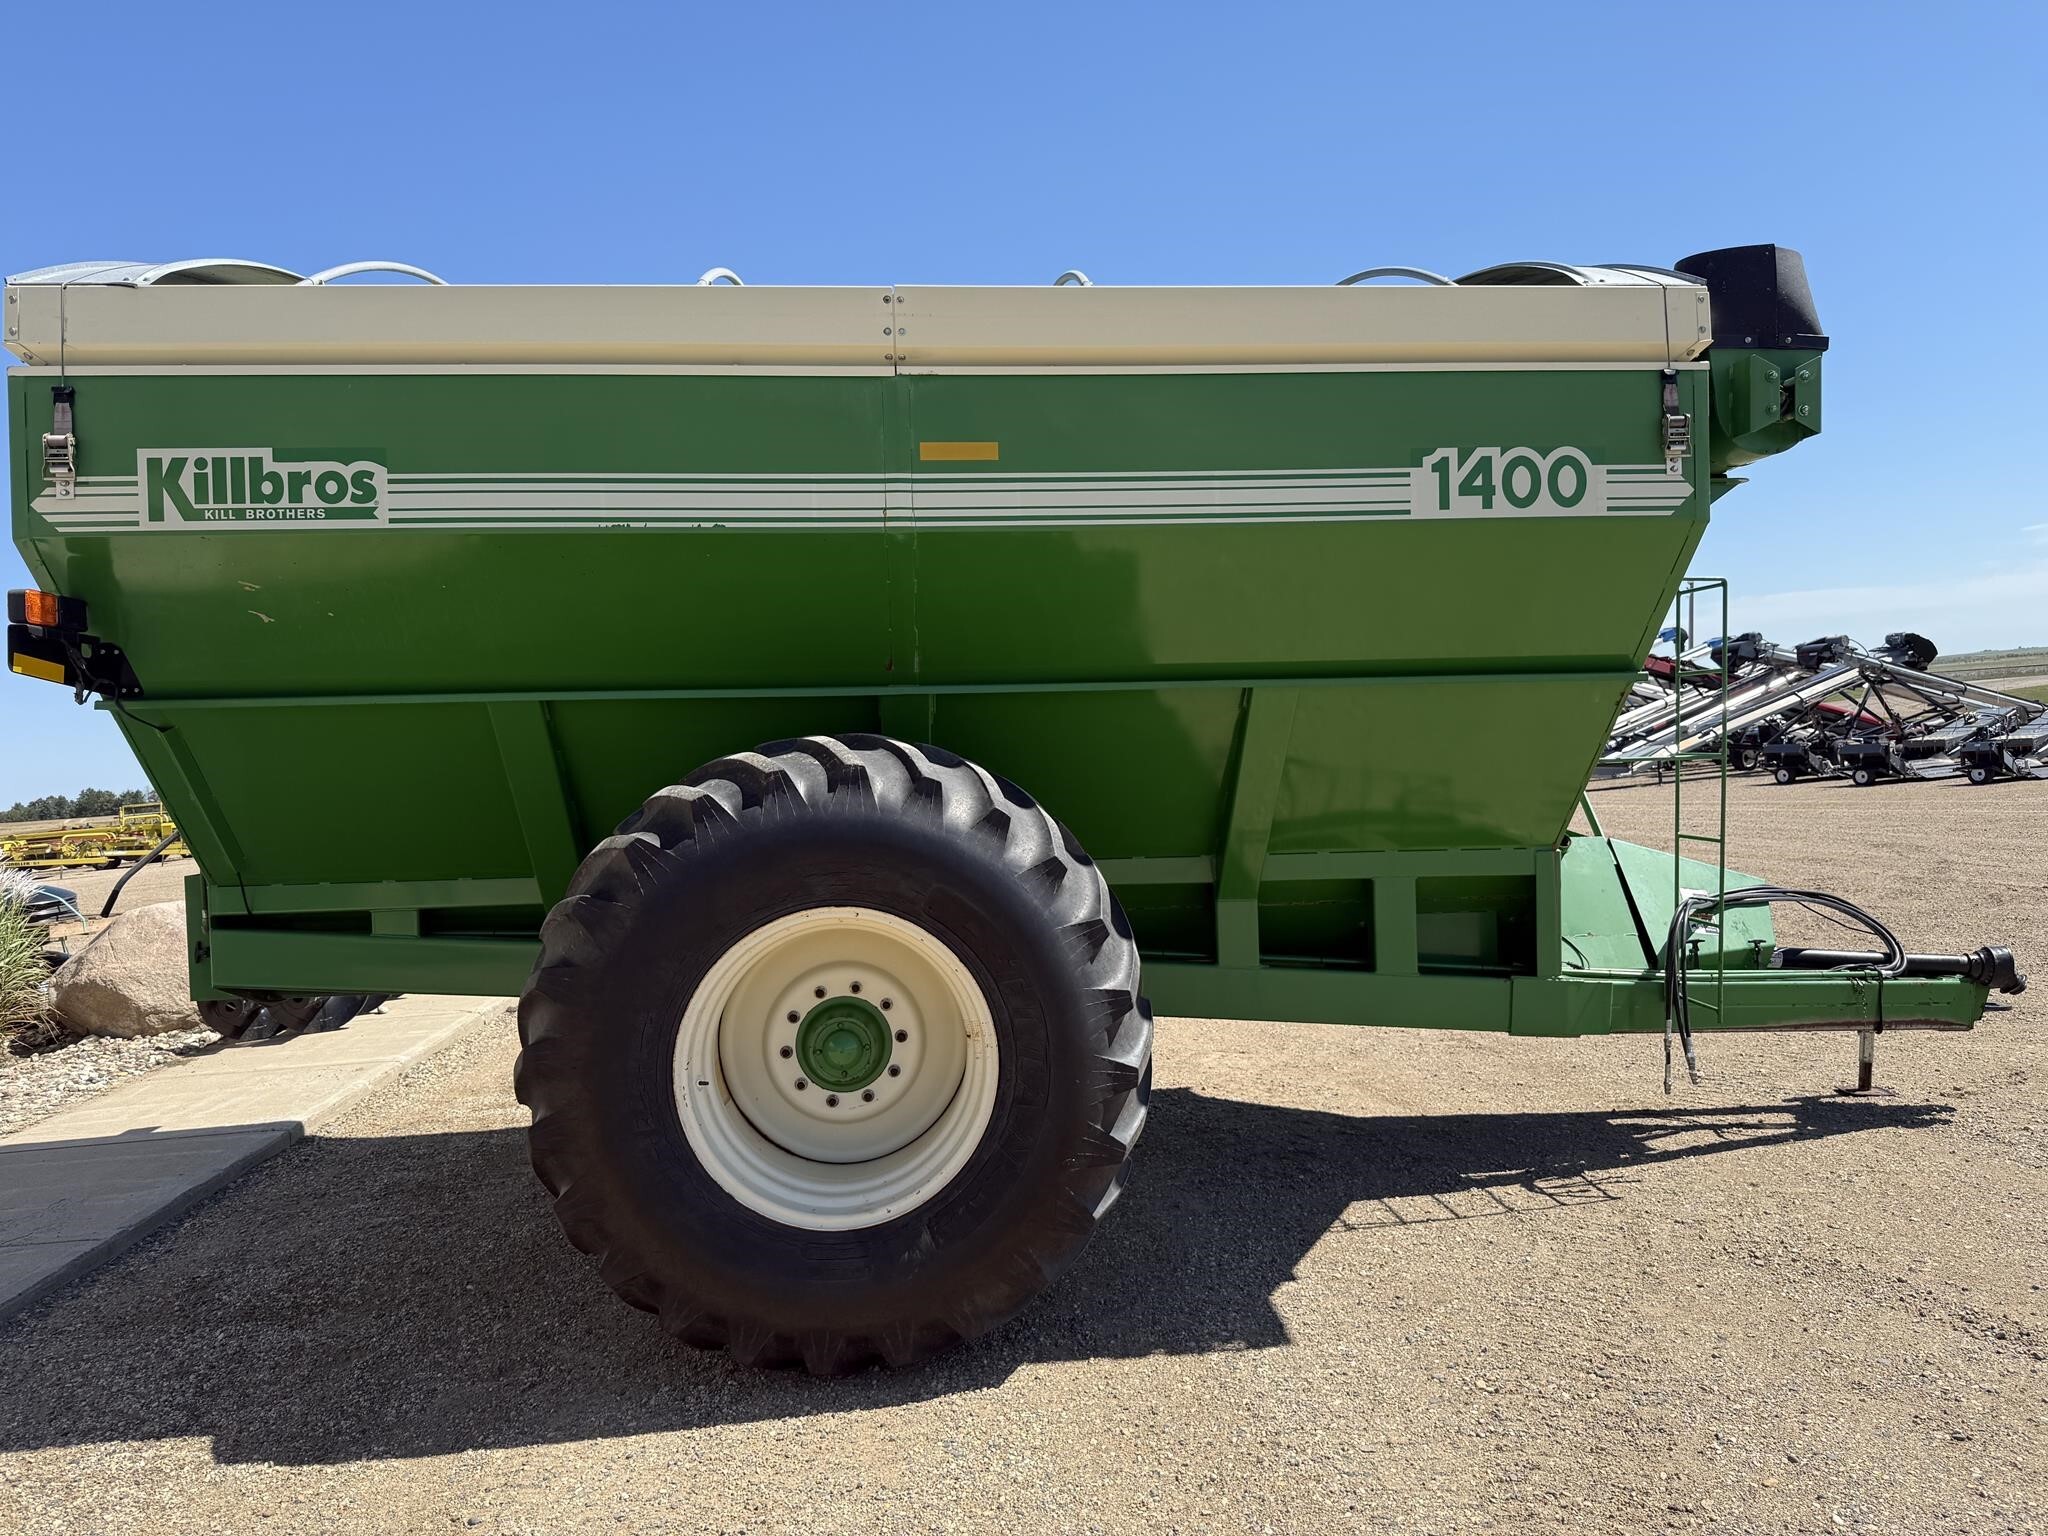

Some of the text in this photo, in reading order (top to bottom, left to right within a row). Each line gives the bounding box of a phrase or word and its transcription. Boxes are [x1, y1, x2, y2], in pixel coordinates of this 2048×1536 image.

[146, 456, 378, 522] Killbros
[1430, 454, 1588, 511] 1400
[204, 507, 327, 520] KILL BROTHERS
